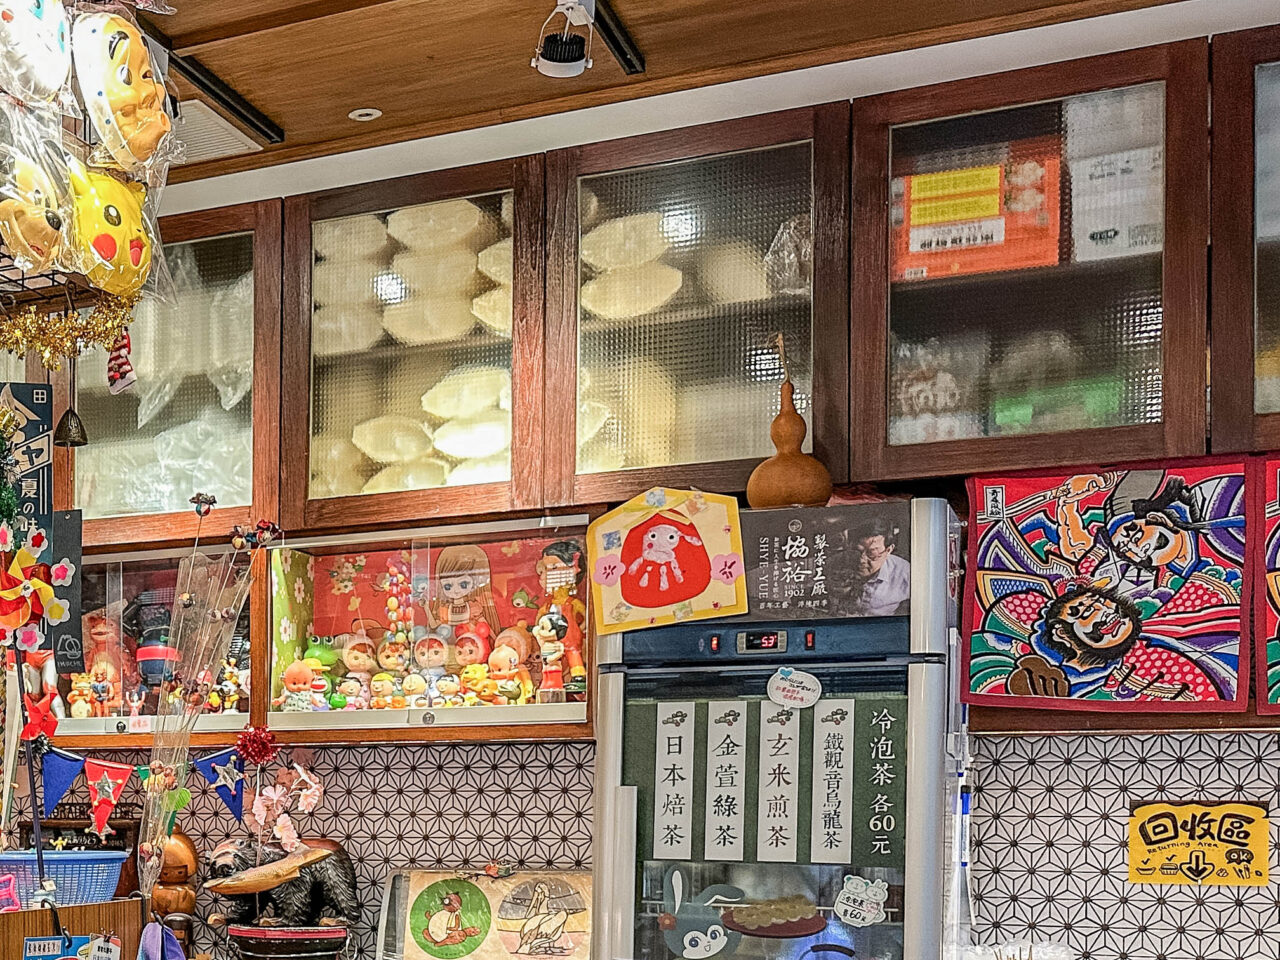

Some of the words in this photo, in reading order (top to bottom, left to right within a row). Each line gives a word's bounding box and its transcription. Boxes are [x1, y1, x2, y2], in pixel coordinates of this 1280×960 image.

[784, 590, 805, 598] 1902
[660, 735, 687, 847] 日本焙茶
[711, 733, 743, 848] 金萱綠茶
[766, 733, 793, 849] 玄米煎茶
[821, 732, 844, 850] 鐵觀音烏龍茶
[1138, 811, 1255, 847] 回收區
[1146, 841, 1192, 854] Returning
